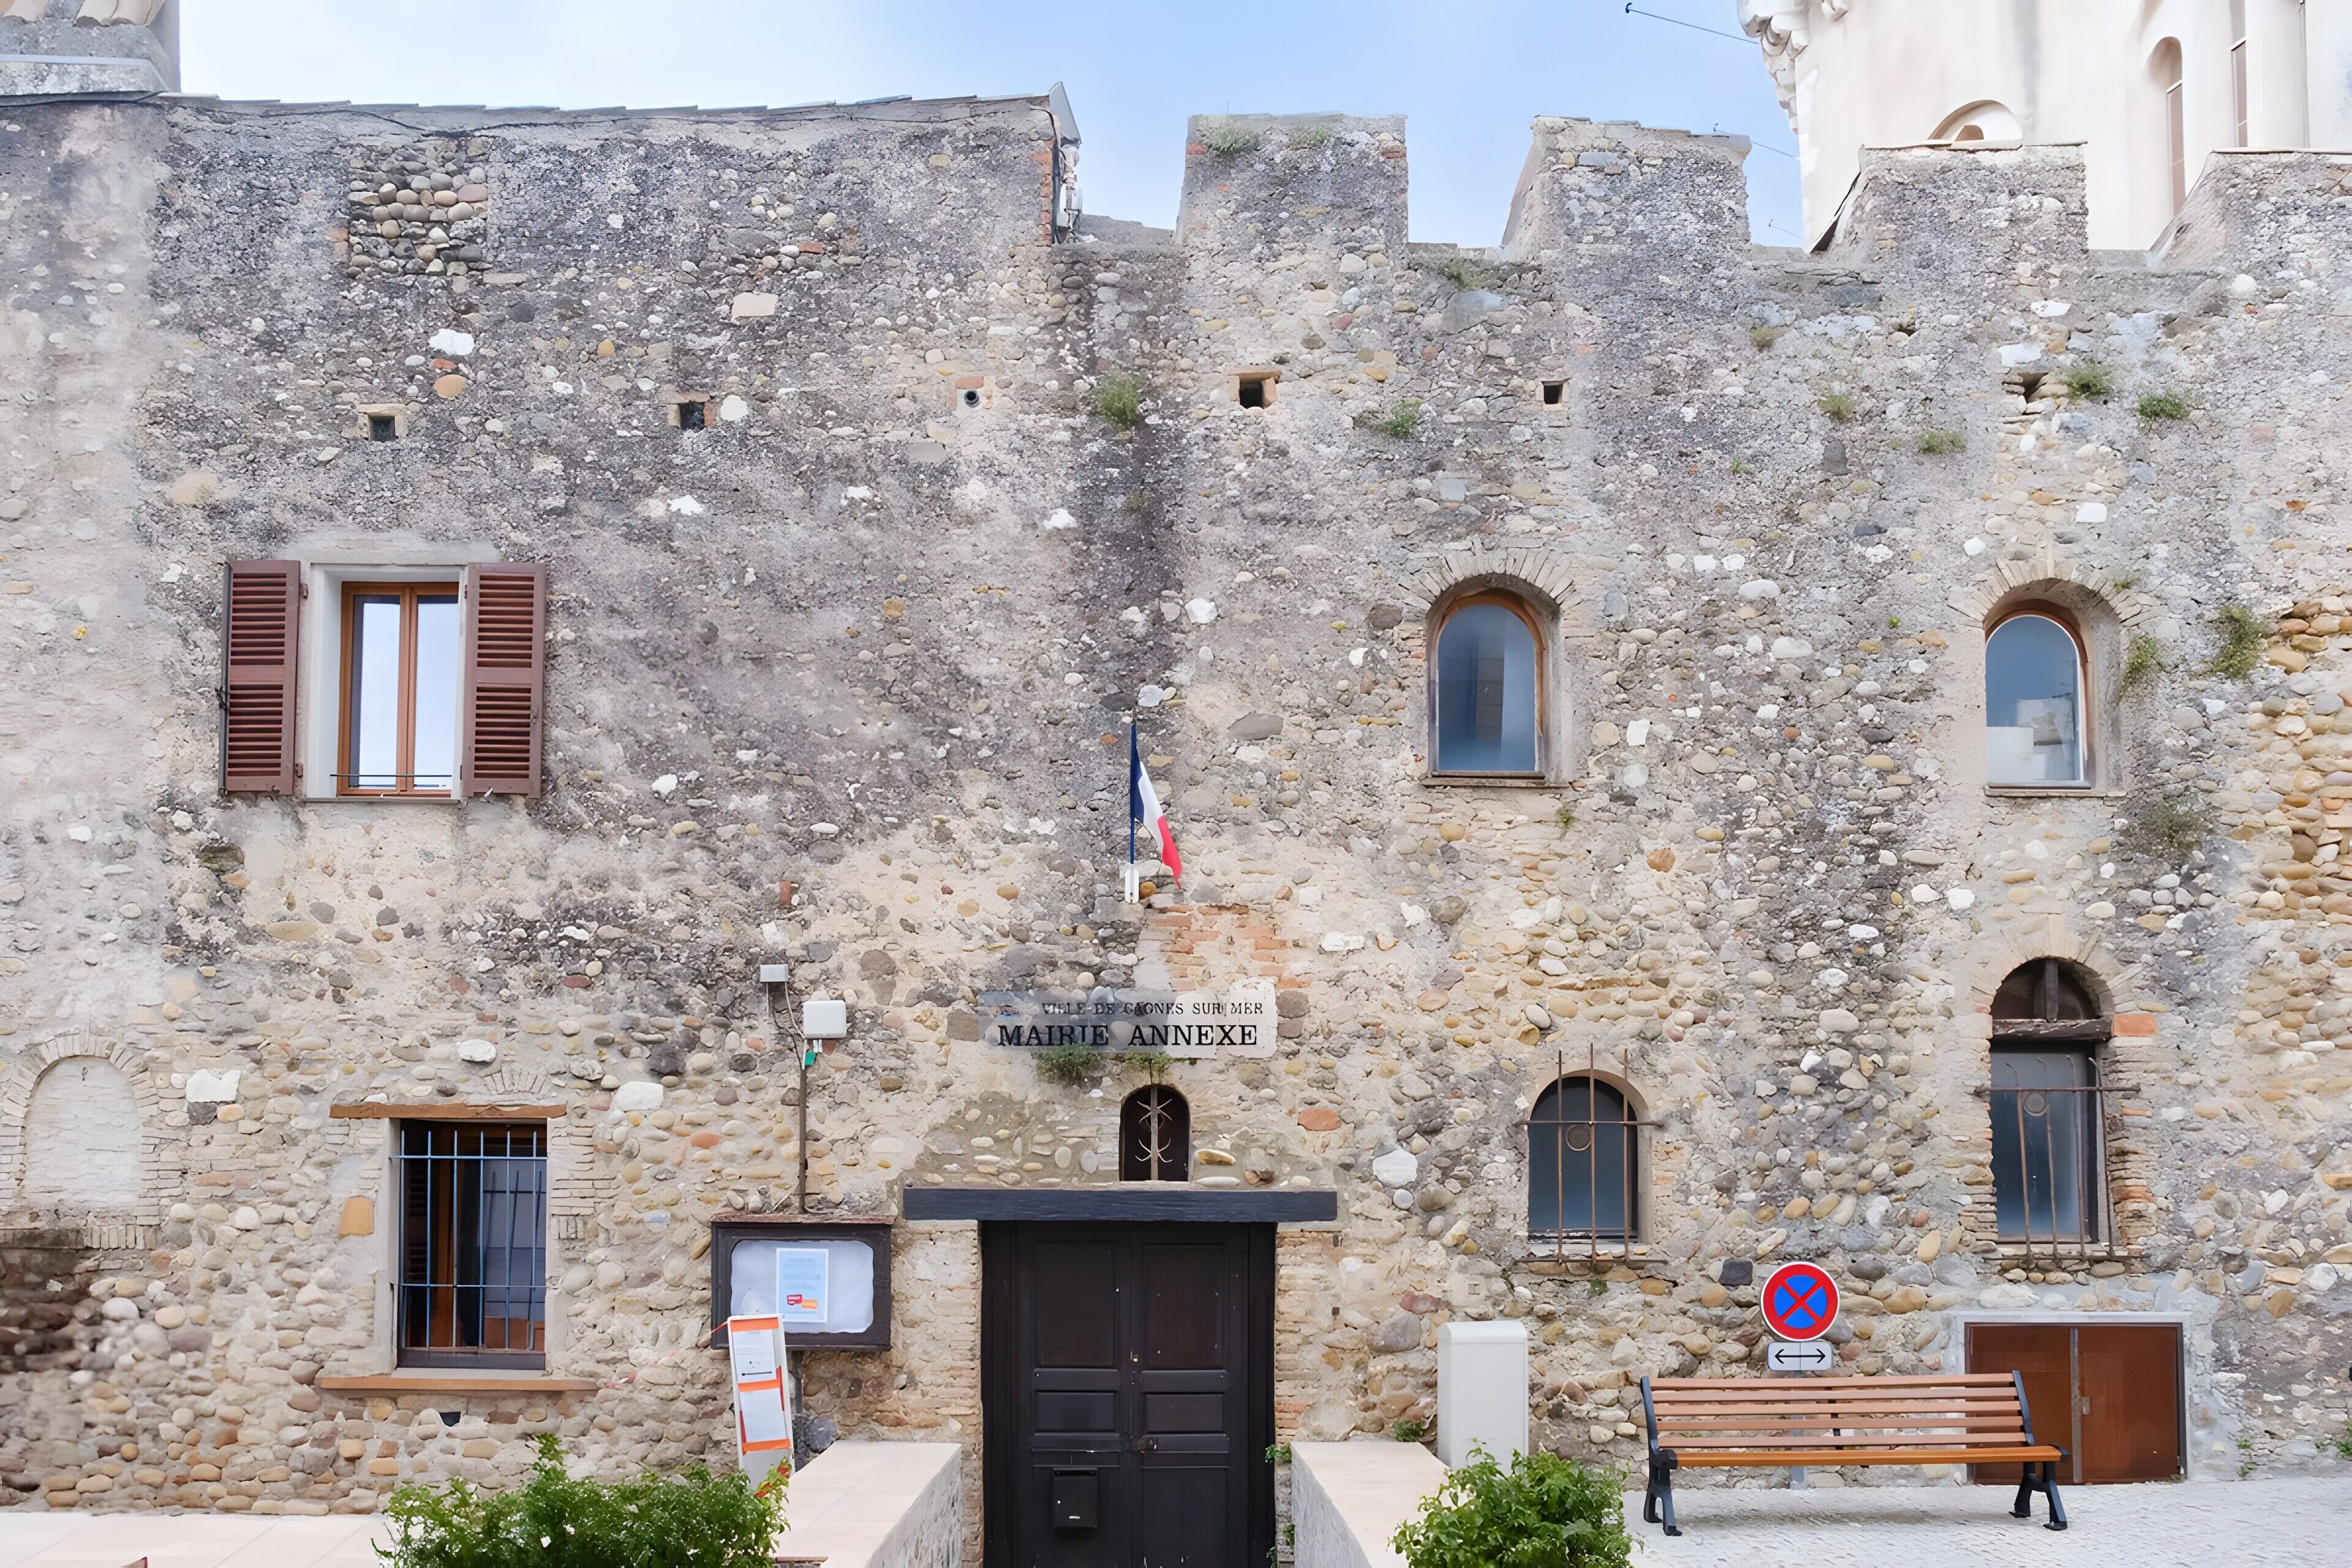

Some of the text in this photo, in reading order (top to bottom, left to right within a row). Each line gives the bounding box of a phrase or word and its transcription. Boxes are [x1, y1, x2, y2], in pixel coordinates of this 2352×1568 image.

[1192, 1002, 1222, 1015] SUR
[1231, 1002, 1263, 1014] MER
[998, 1024, 1257, 1046] MAIRIE ANNEXE
